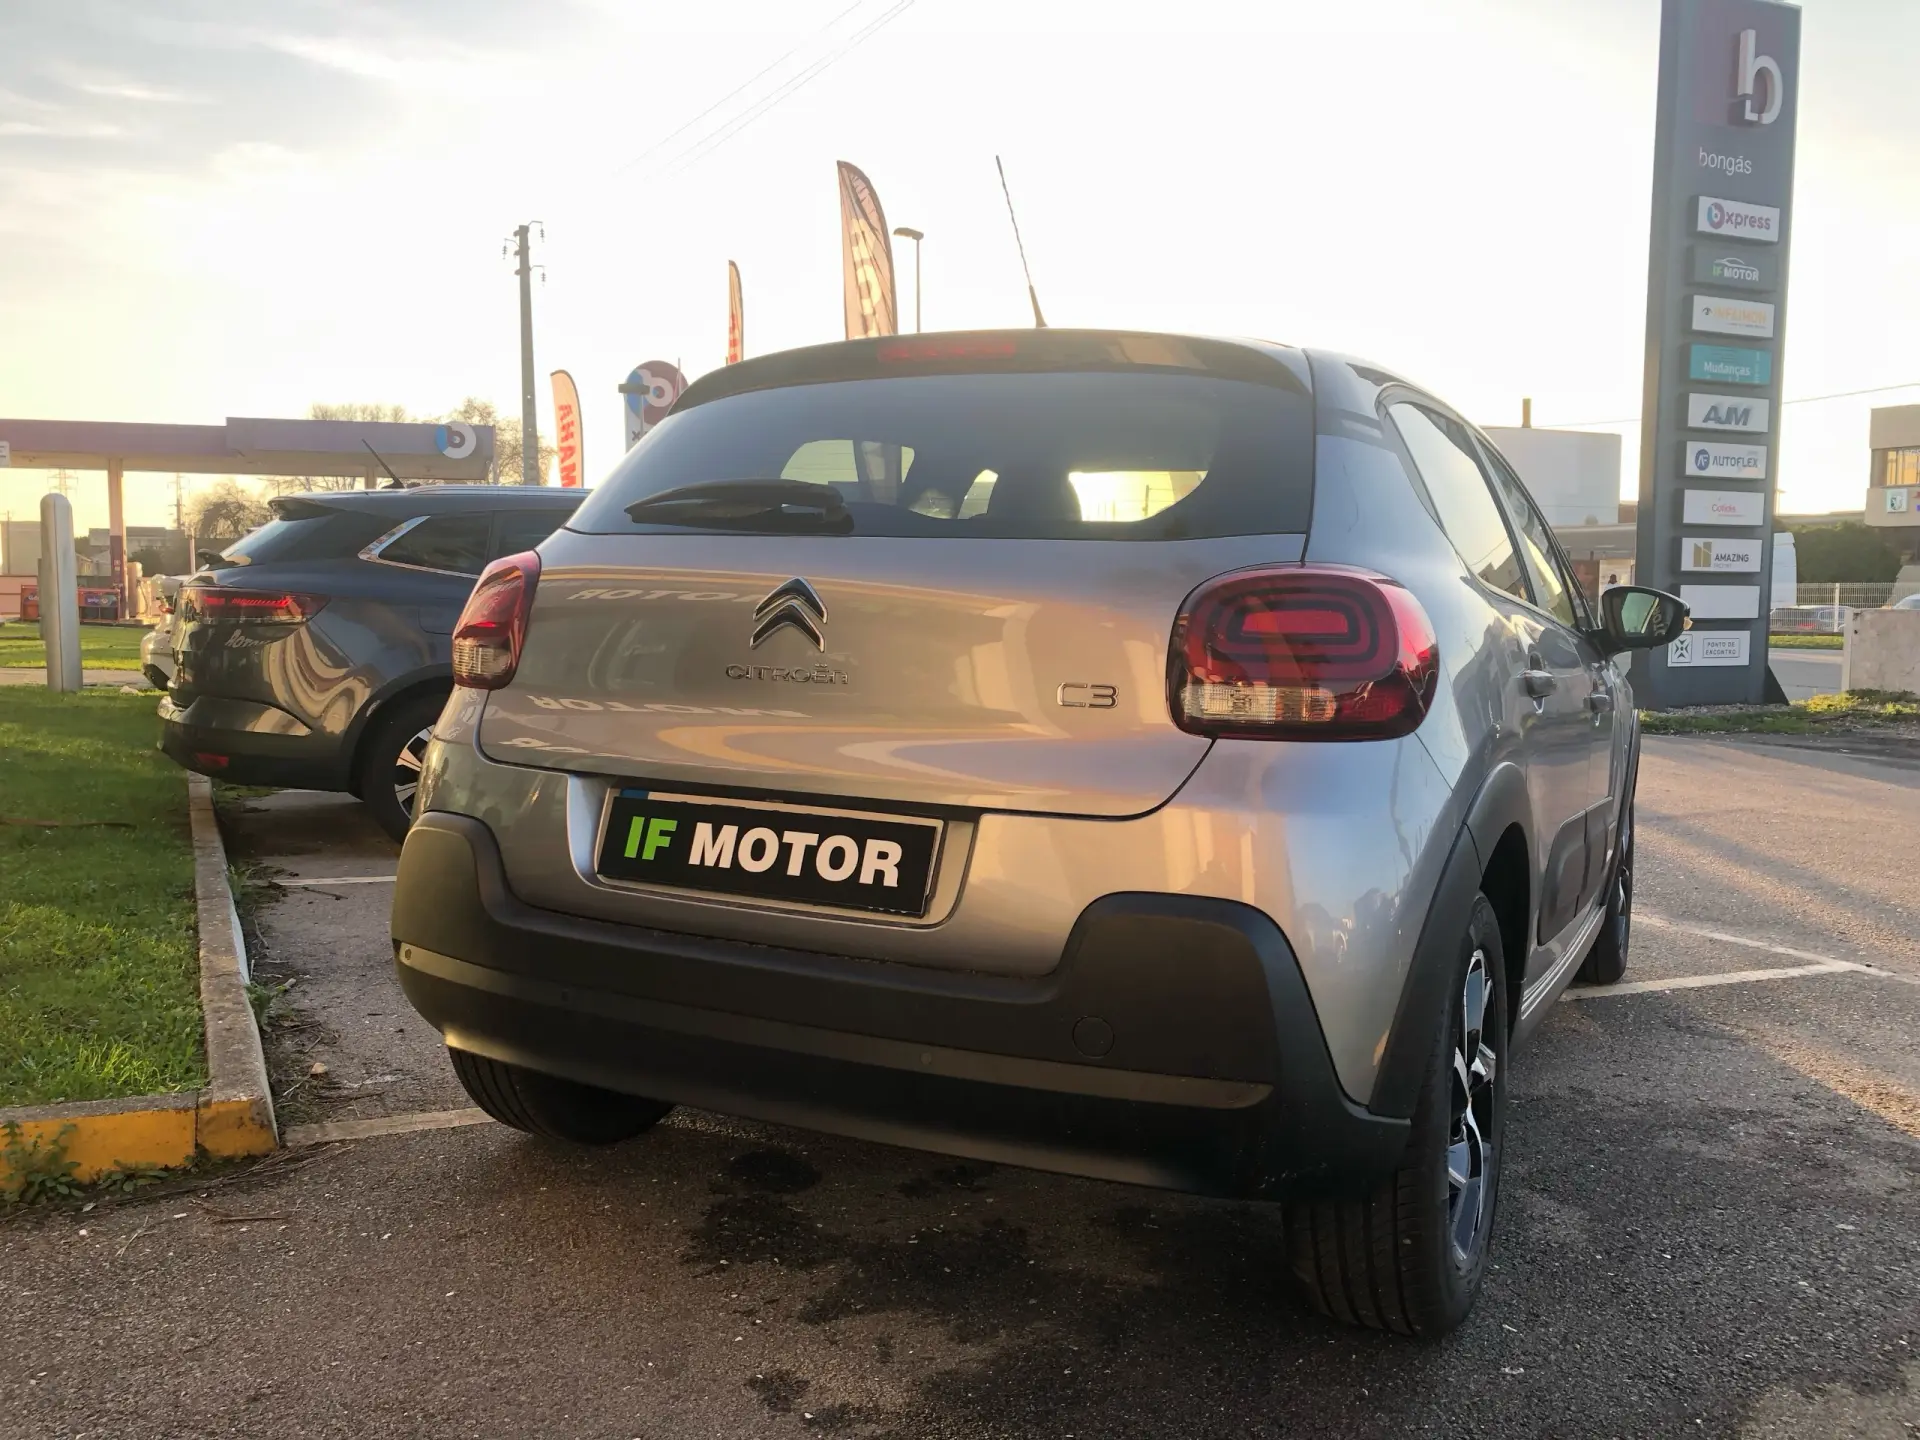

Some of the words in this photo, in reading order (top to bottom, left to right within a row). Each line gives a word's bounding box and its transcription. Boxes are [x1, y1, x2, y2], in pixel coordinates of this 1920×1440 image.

[1699, 147, 1752, 176] bongás
[1723, 267, 1759, 281] MOTOR
[1704, 361, 1751, 377] Mudanças
[1702, 405, 1750, 426] AJM
[1711, 455, 1759, 469] AUTOFLEX
[1714, 553, 1750, 563] AMAZING
[1056, 682, 1119, 709] C3
[624, 815, 677, 861] IF
[688, 821, 903, 888] MOTOR
